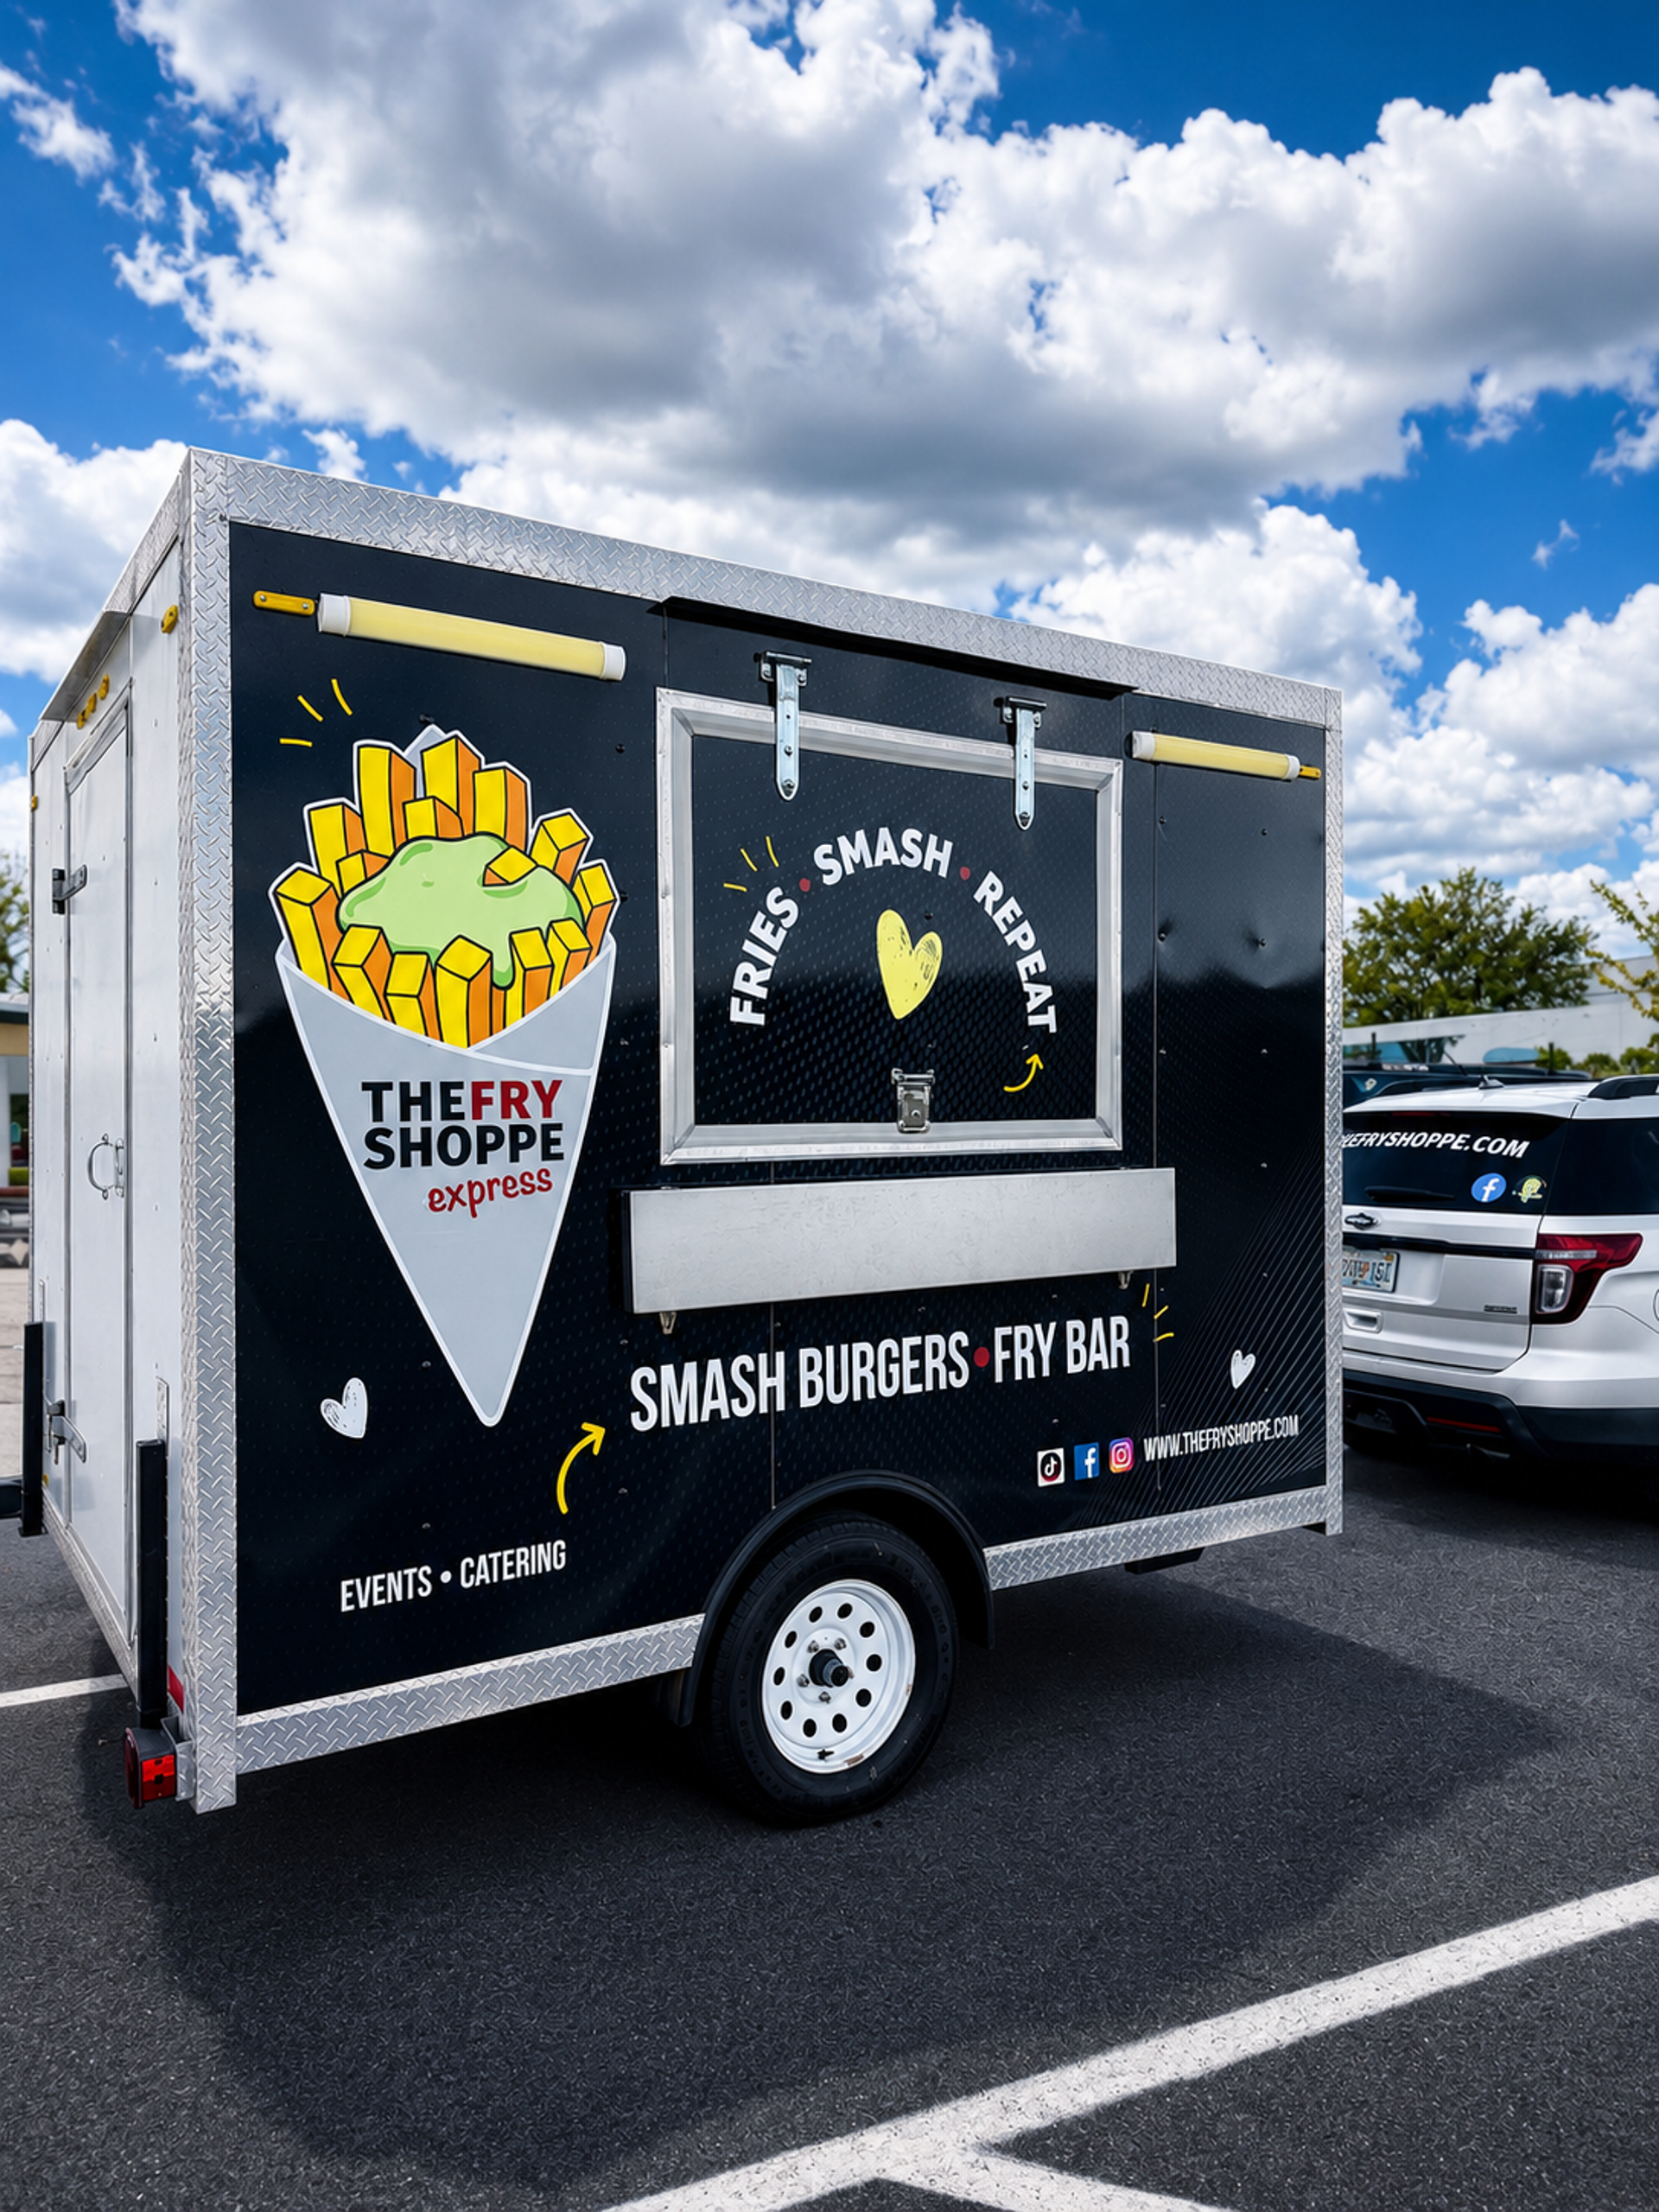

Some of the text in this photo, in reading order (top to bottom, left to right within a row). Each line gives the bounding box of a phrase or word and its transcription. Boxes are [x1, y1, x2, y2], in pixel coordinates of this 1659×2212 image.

[729, 827, 1057, 1033] FRIES SMASH REPEAT
[363, 1123, 564, 1170] SHOPPE
[427, 1168, 553, 1218] express
[630, 1315, 1130, 1432] SMASH BURGERS FRY BAR
[1143, 1414, 1300, 1462] WWW.THEFRYSHOPPE.COM
[340, 1540, 566, 1612] EVENTS CATERING
